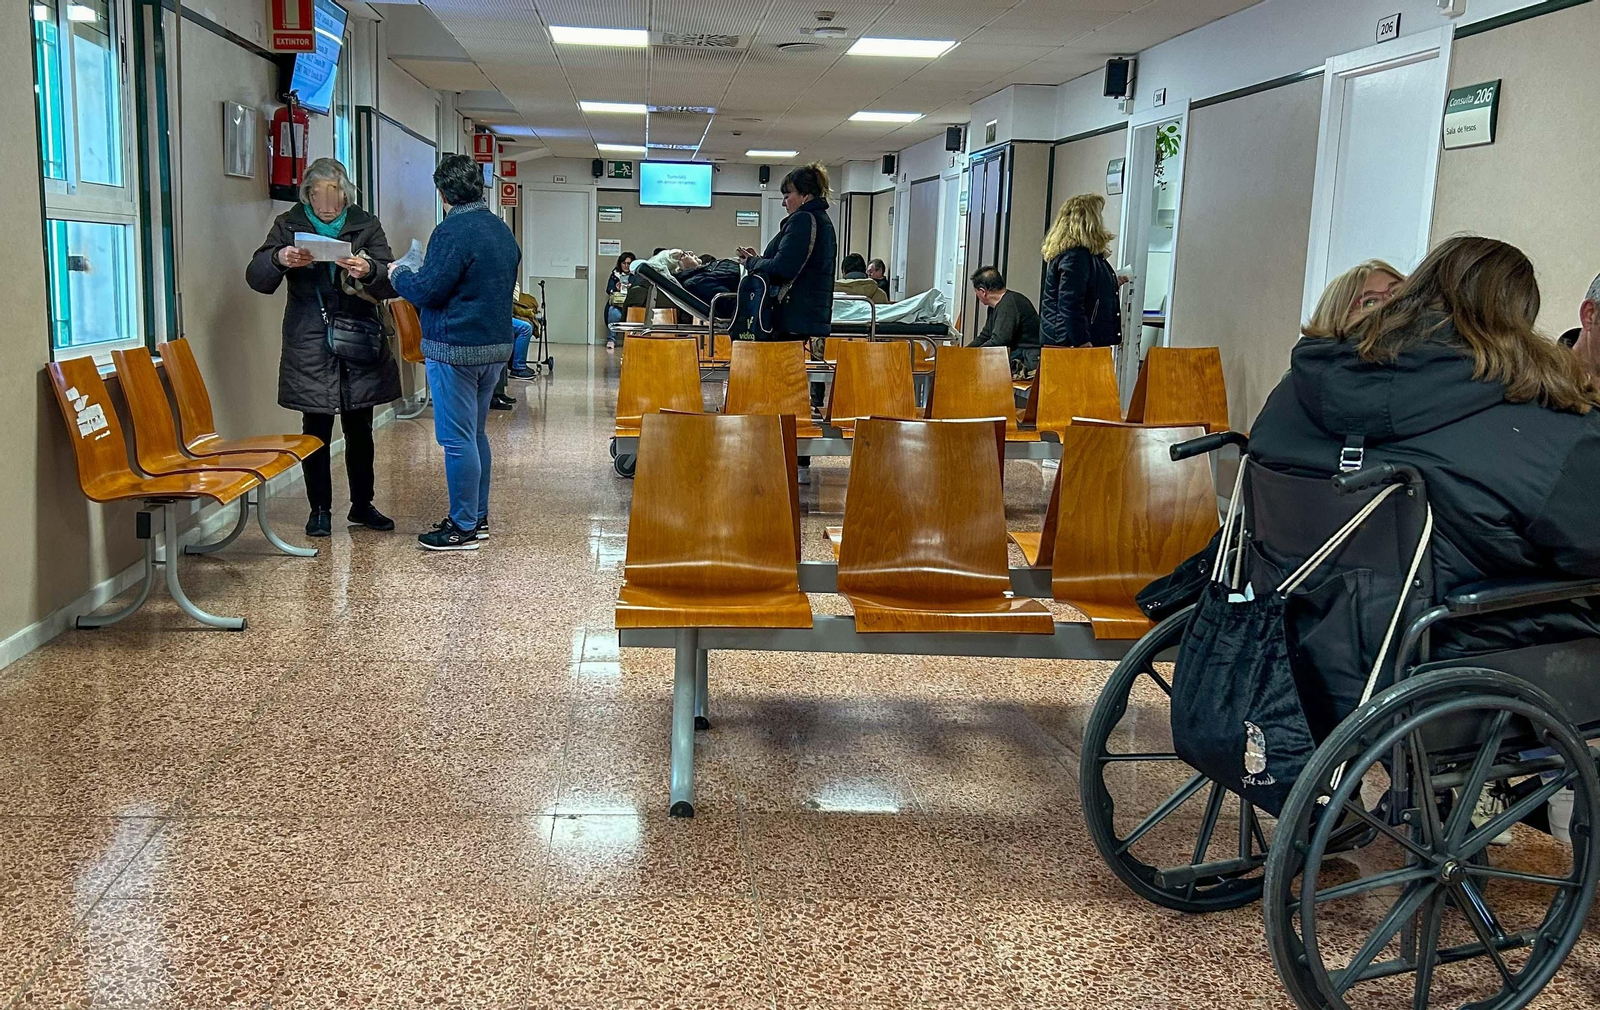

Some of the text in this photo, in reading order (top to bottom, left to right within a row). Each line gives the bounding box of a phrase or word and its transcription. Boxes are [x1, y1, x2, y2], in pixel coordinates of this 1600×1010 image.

[1380, 21, 1393, 35] 206
[1450, 87, 1493, 106] Consulta 206
[1446, 124, 1476, 135] Sala de Yesos
